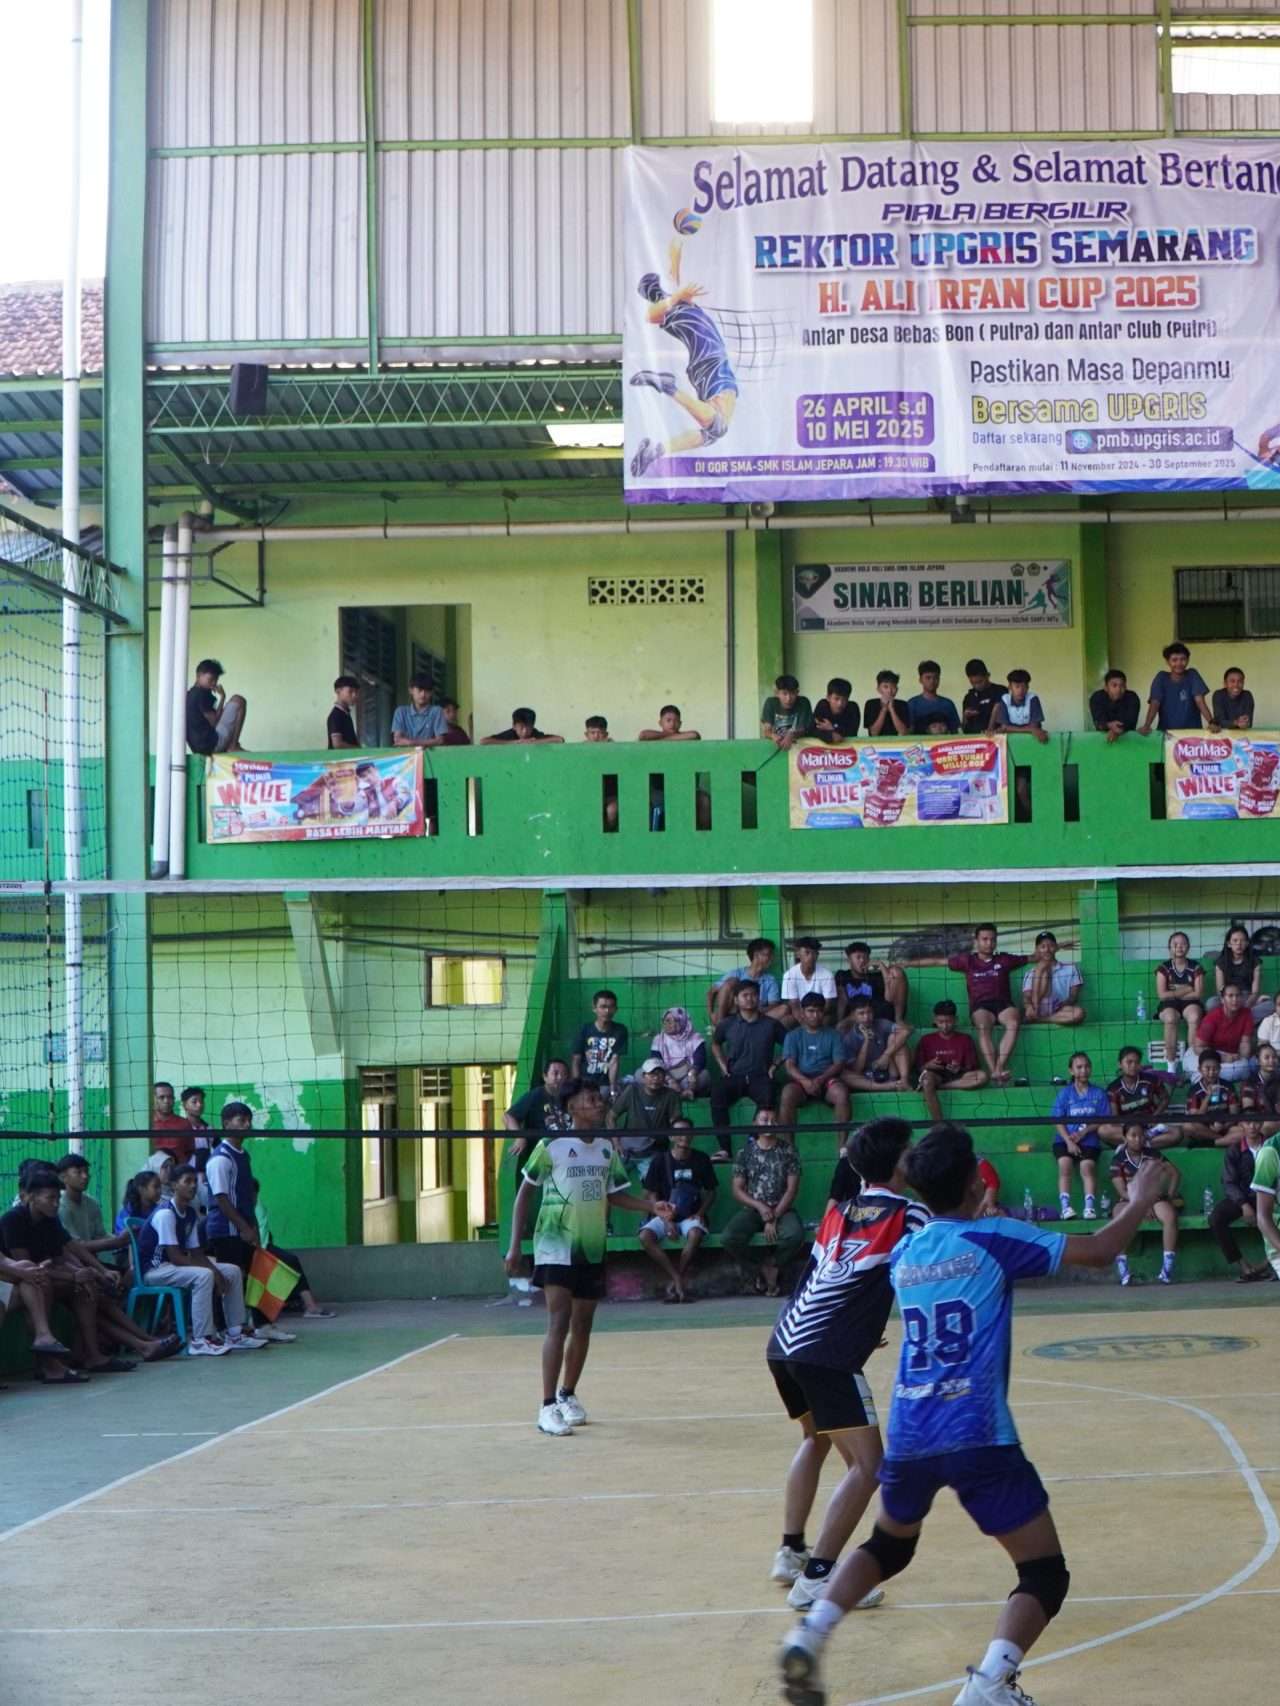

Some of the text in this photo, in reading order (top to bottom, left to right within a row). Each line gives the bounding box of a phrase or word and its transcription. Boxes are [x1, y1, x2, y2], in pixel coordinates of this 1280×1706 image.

[693, 155, 828, 213] Selamat
[841, 155, 960, 195] Datang
[972, 153, 1001, 183] &
[1012, 152, 1148, 185] Selamat
[881, 202, 1128, 223] PIALA BERGILIR
[754, 227, 1256, 269] REKTOR UPGRIS SEMARANG
[818, 274, 1198, 314] H. ALI IRFAN CUP 2025
[802, 329, 846, 346] Antar
[850, 326, 889, 344] Desa
[893, 326, 940, 343] Bebas
[945, 324, 974, 342] Bon
[1045, 322, 1074, 340] dan
[1080, 321, 1123, 340] Antar
[1127, 320, 1161, 339] Club
[1166, 320, 1217, 340] (Putri)
[970, 357, 1231, 386] Pastikan Masa Depanmu
[803, 397, 927, 417] 26 APRIL s.d
[971, 392, 1208, 424] Bersama UPGRIS
[807, 420, 924, 441] 10 MEI 2025
[972, 431, 1063, 449] Daftar sekarang
[1097, 430, 1221, 450] pmb.upgris.ac.id
[695, 462, 706, 473] DI
[708, 462, 728, 473] GOR
[730, 460, 778, 472] SMA-SMK
[782, 460, 814, 472] ISLAM
[815, 459, 853, 471] JEPARA
[855, 458, 876, 470] JAM
[909, 457, 930, 469] WIB
[972, 461, 1026, 474] Pendaftaran
[1029, 461, 1054, 471] mulai
[1061, 460, 1069, 471] 11
[1070, 460, 1115, 471] November
[1118, 459, 1139, 470] 2024
[1149, 459, 1162, 470] 30
[1164, 459, 1212, 471] September
[833, 580, 1024, 609] SINAR BERLIAN
[801, 754, 853, 767] MariMas
[1178, 745, 1228, 758] MariMas
[217, 783, 289, 805] WILLIE
[802, 785, 859, 807] WILLIE
[1178, 776, 1234, 797] WILLIE
